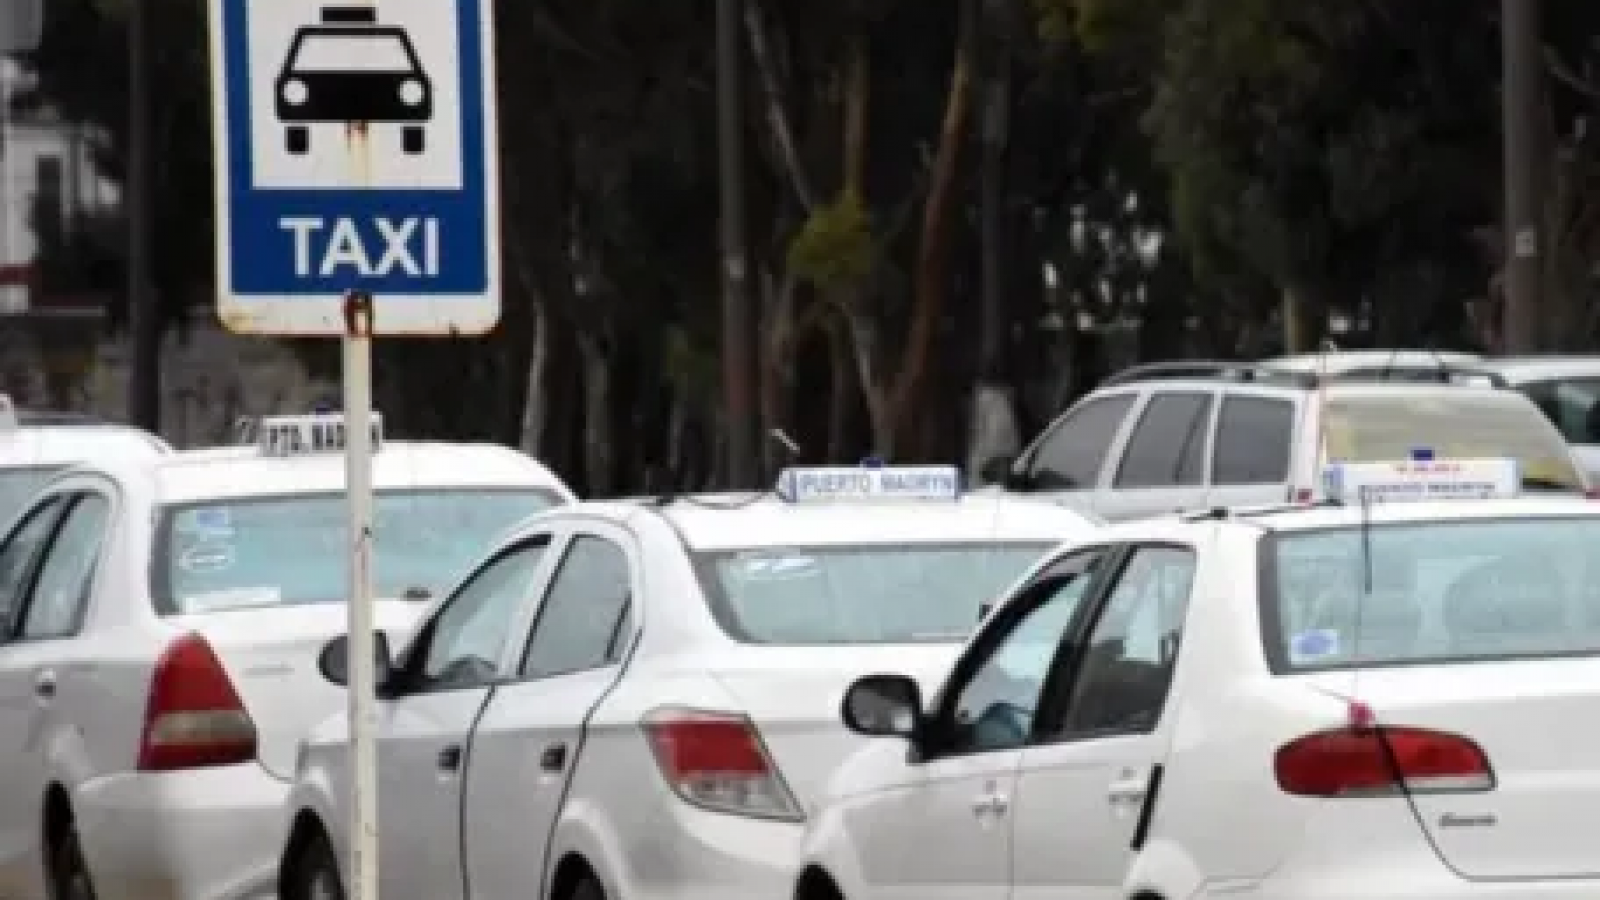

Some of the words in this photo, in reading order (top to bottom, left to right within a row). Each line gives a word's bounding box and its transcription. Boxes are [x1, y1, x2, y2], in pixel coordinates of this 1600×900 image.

[278, 216, 440, 277] TAXI
[799, 474, 871, 493] PUERTO
[880, 474, 954, 492] MADRYN
